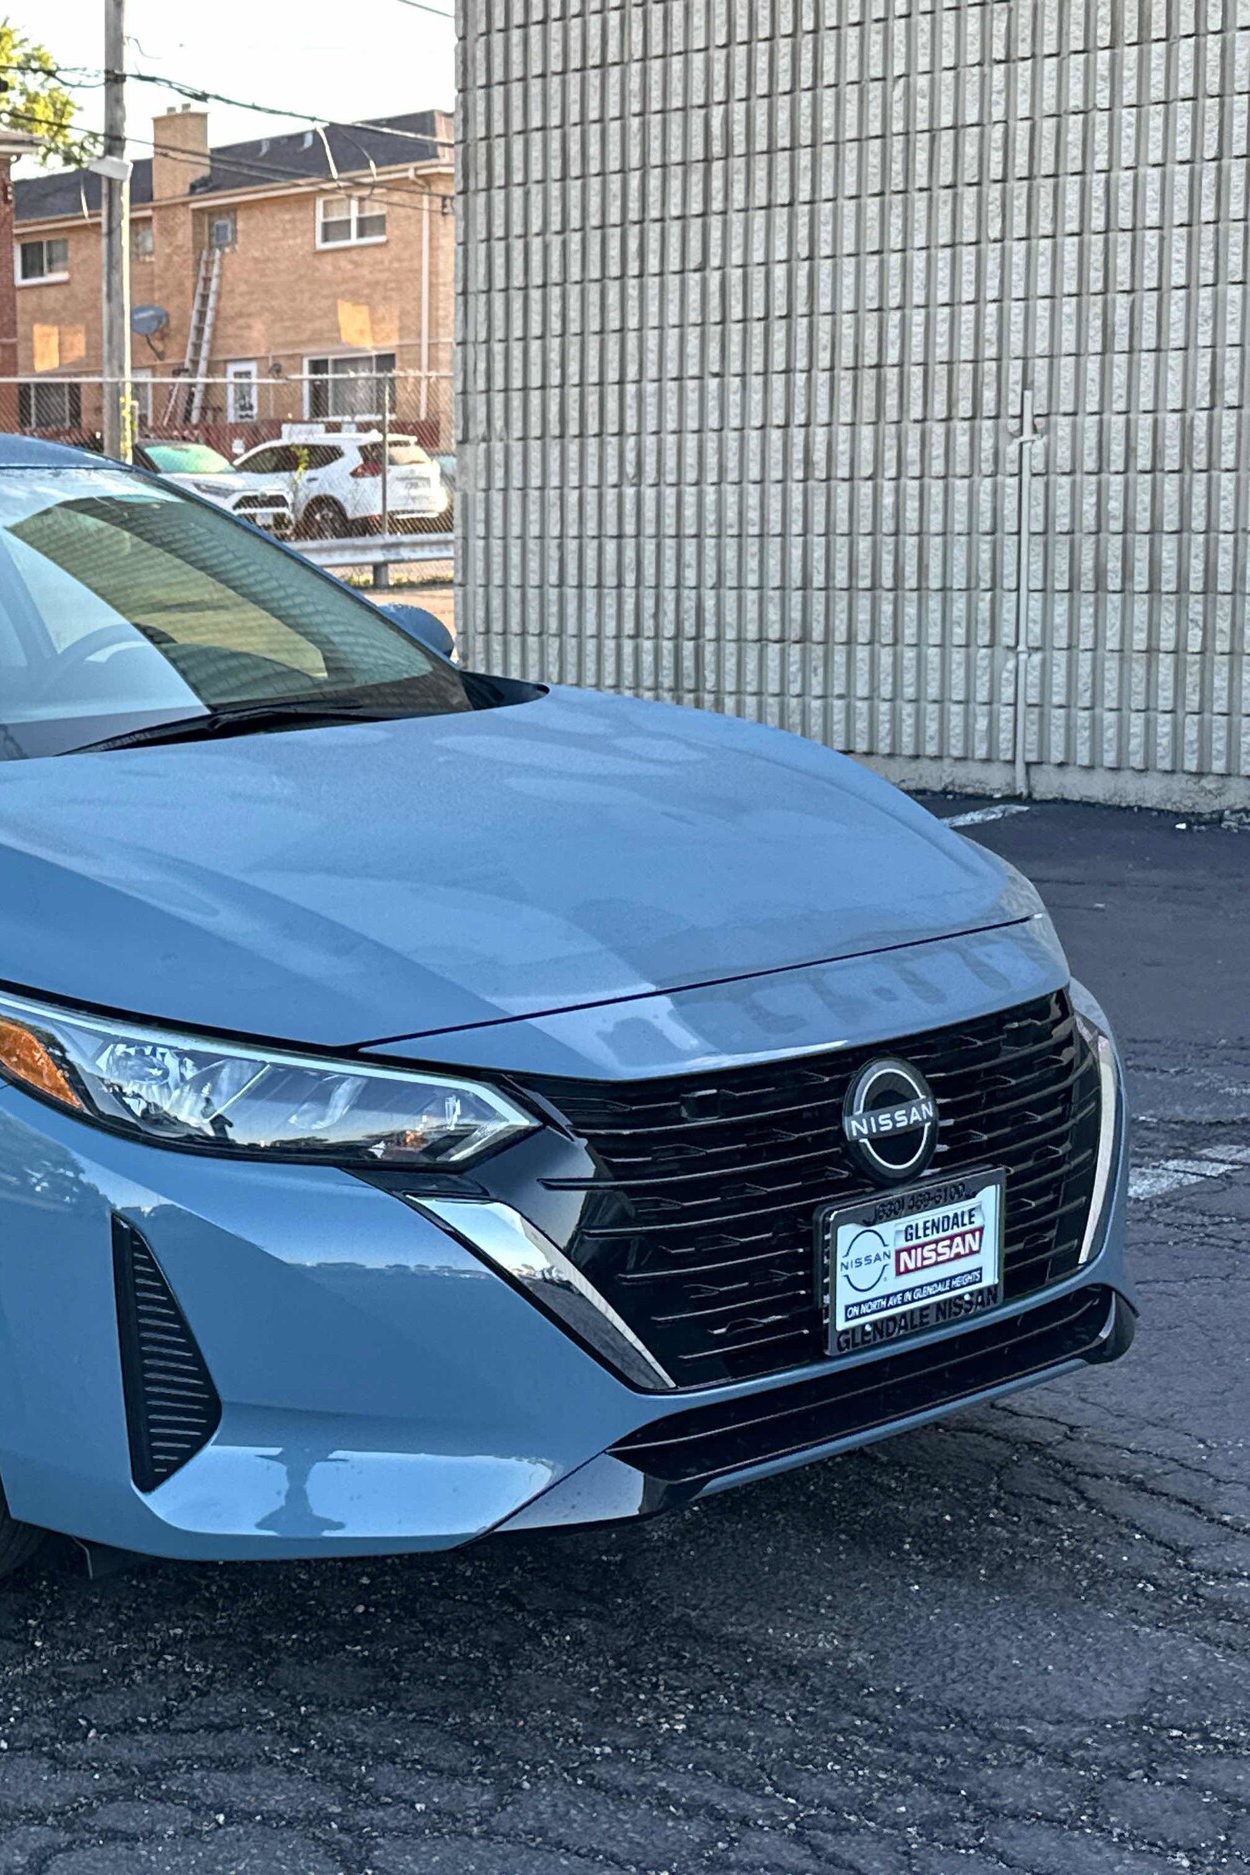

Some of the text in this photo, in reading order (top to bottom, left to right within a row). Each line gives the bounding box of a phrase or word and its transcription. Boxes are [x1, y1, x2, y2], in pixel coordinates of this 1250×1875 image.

[851, 1102, 934, 1137] NISSAN
[904, 1207, 976, 1242] GLENDALE
[840, 1251, 891, 1272] NISSAN
[899, 1231, 980, 1273] NISSAN
[846, 1270, 981, 1318] ON NORTH AVE IN GLENDALE HEIGHTS
[837, 1288, 998, 1353] GLENDALE NISSAN
